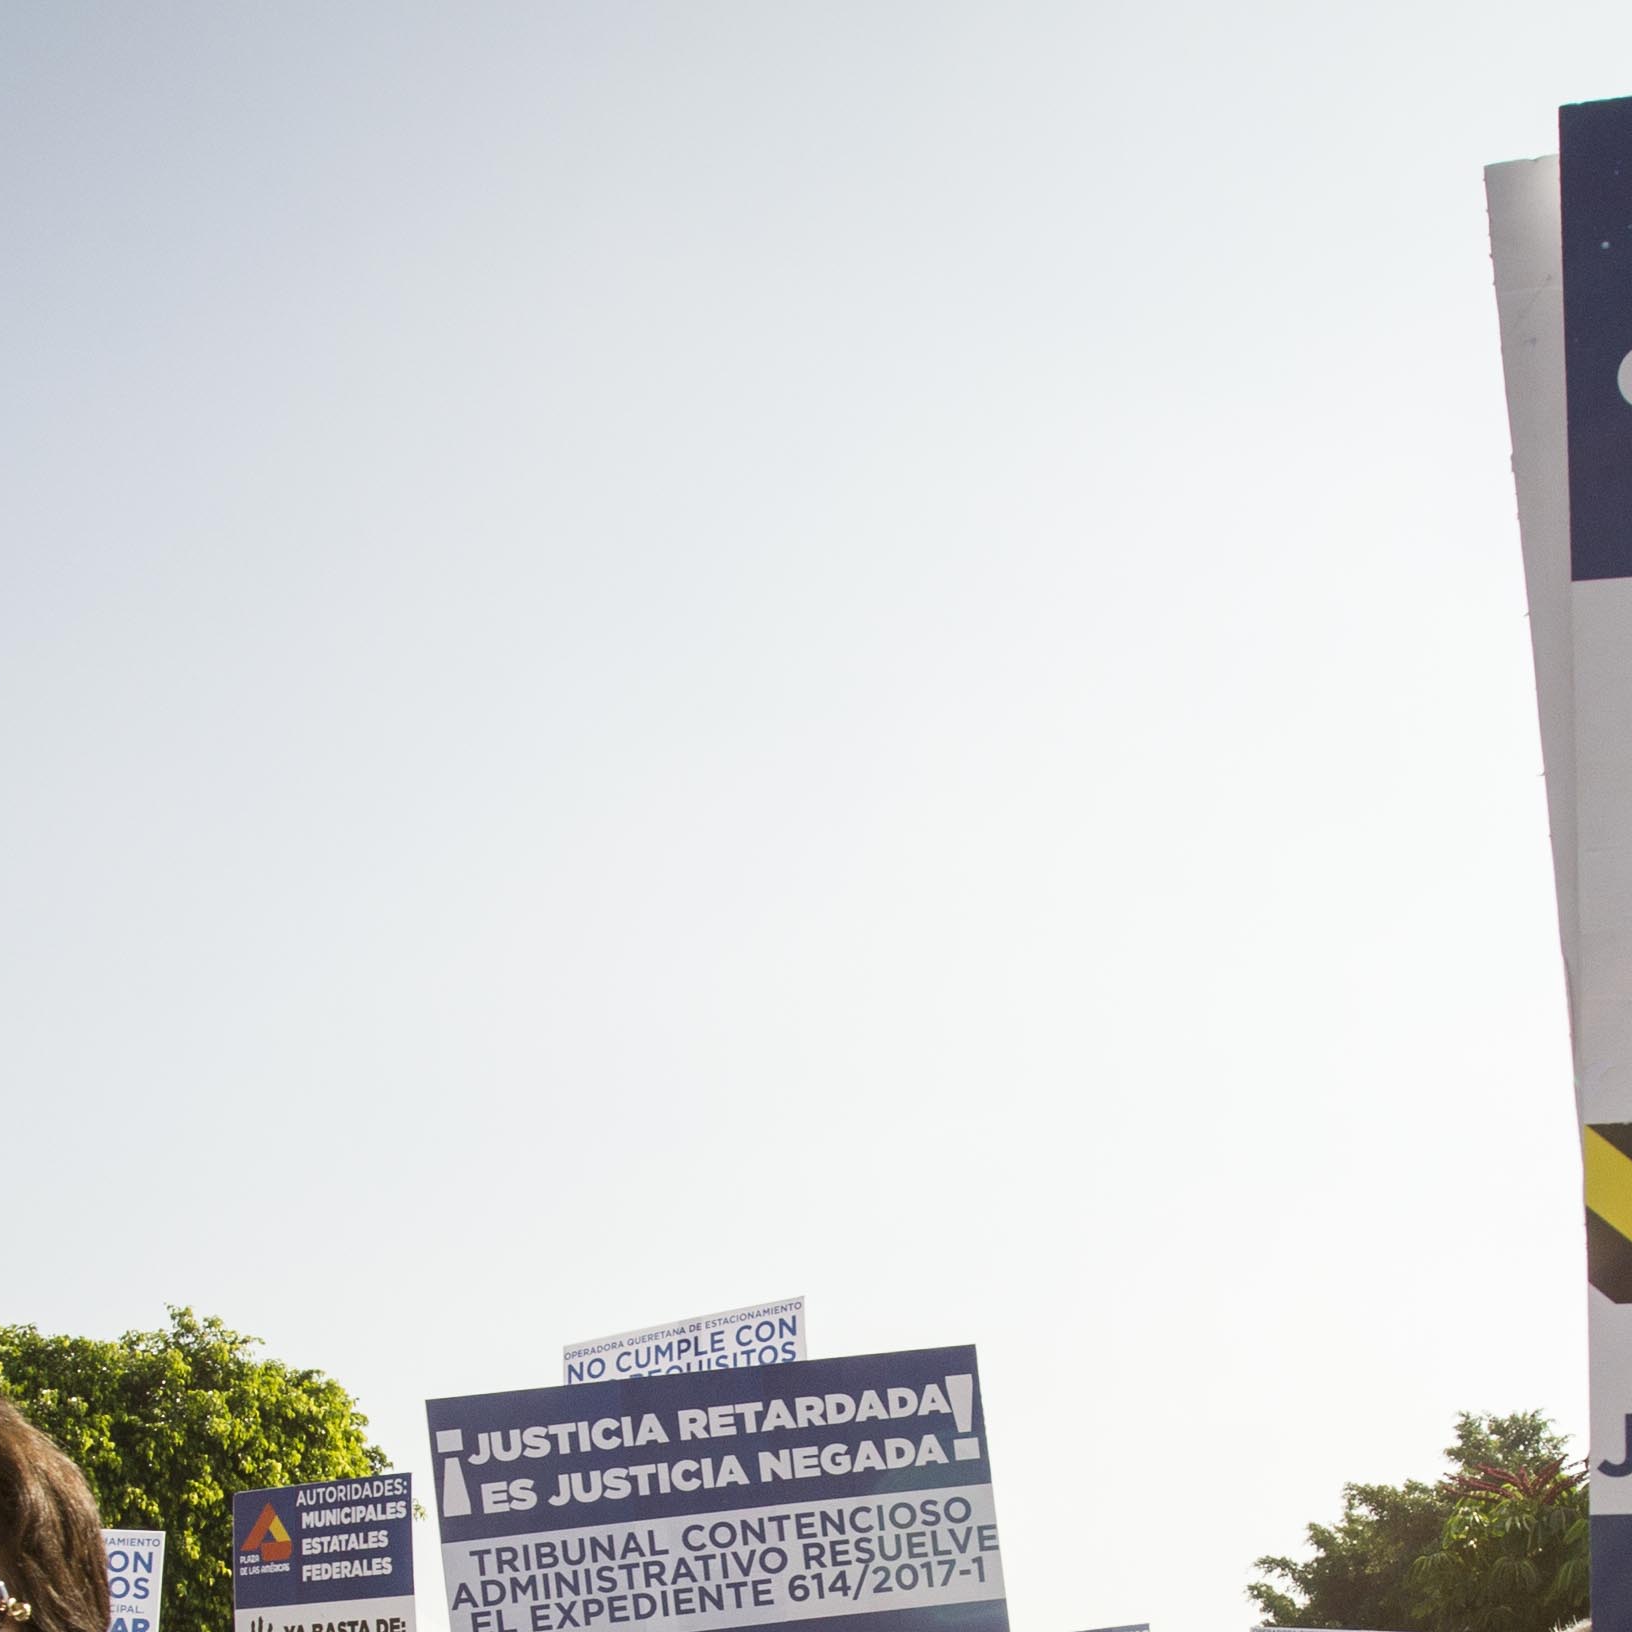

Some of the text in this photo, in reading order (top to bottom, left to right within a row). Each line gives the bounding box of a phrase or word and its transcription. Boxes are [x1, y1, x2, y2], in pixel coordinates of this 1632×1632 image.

[565, 1302, 802, 1360] OPERADORA QUERETANA DE ESTACIONAMIENTO
[568, 1315, 797, 1384] NO CUMPLE CON
[296, 1479, 407, 1507] AUTORIDADES:
[481, 1479, 537, 1514] ES
[548, 1455, 750, 1506] JUSTICIA
[302, 1501, 407, 1529] MUNICIPALES
[302, 1530, 389, 1555] ESTATALES
[469, 1497, 971, 1576] TRIBUNAL CONTENCIOSO
[303, 1558, 392, 1582] FEDERALES
[452, 1524, 999, 1610] ADMINISTRATIVO RESUELVE
[530, 1579, 774, 1632] EXPEDIENTE
[788, 1556, 985, 1602] 614/2017-1
